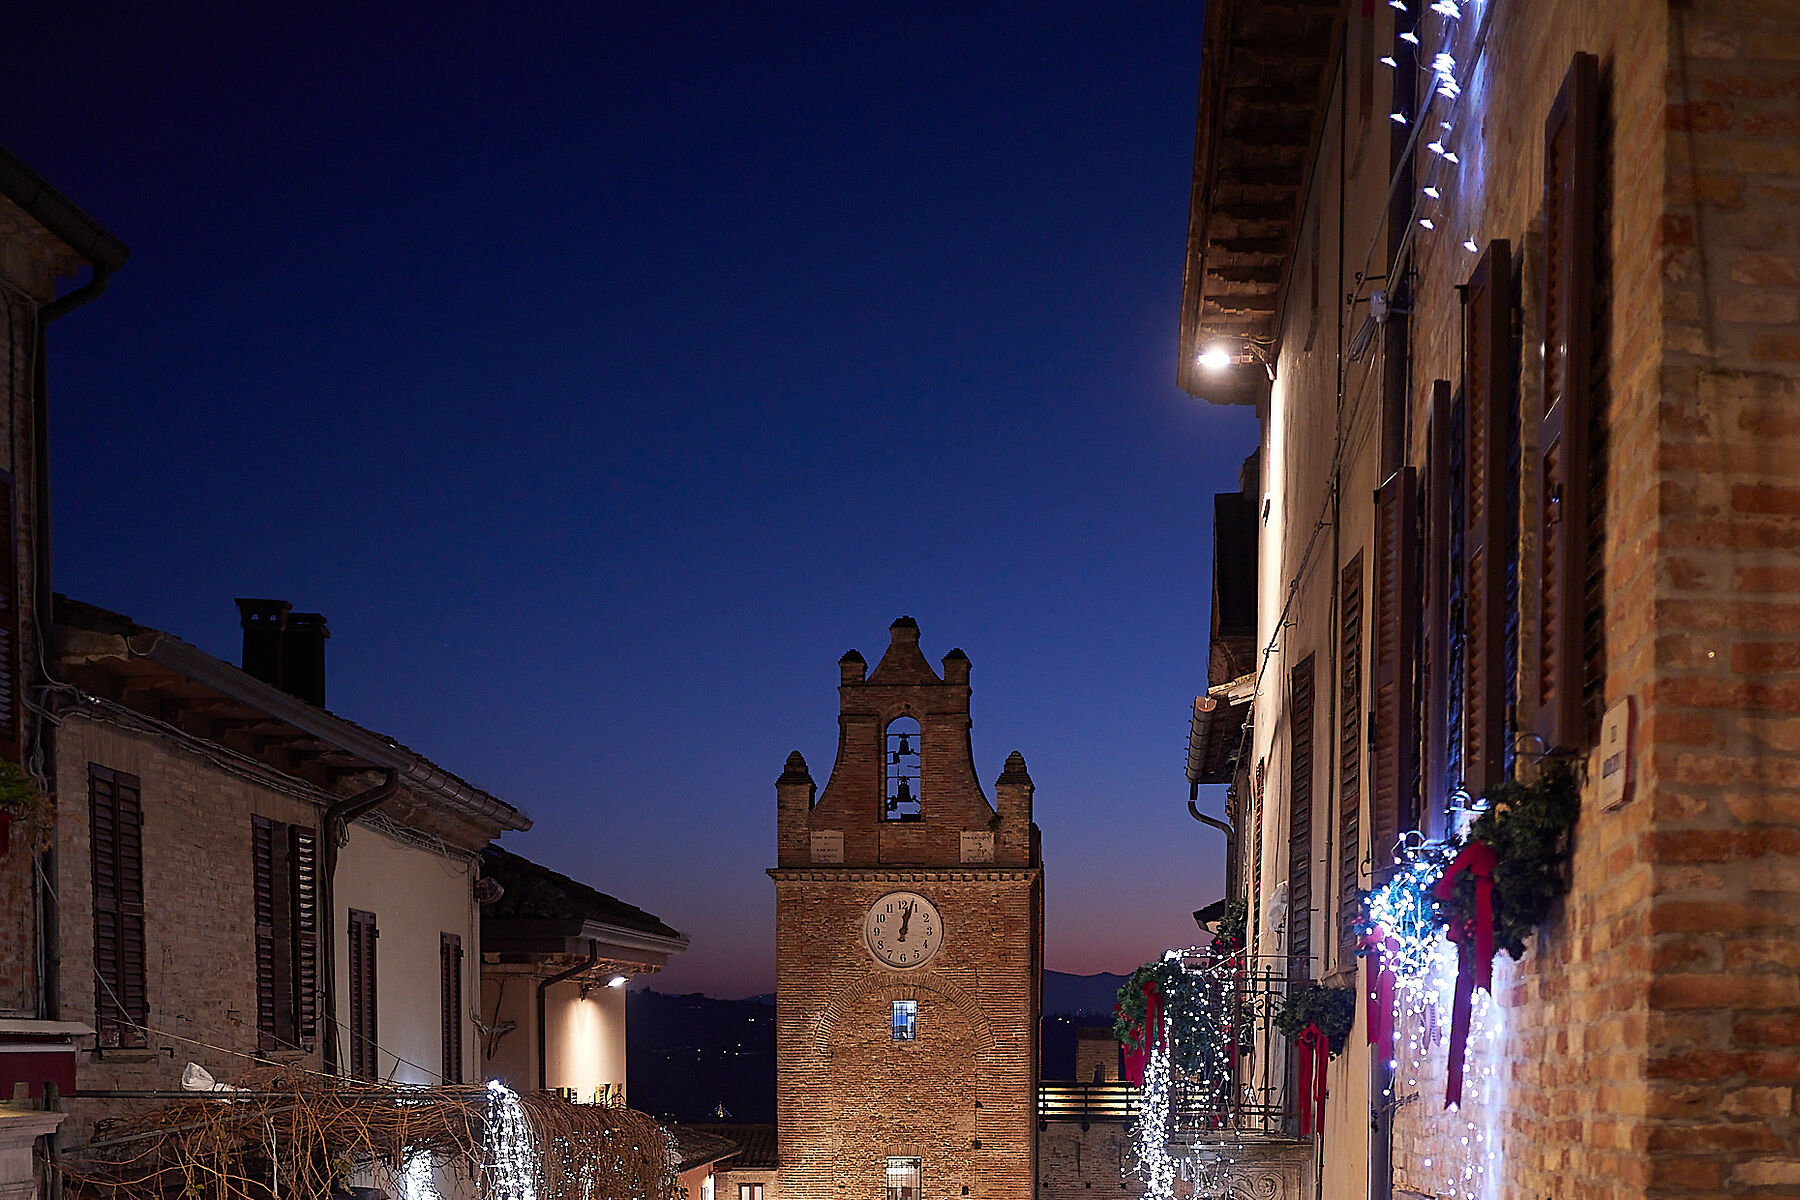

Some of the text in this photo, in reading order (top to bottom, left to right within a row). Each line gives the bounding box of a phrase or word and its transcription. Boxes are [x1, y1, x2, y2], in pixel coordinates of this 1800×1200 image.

[886, 904, 893, 913] 11
[898, 901, 908, 910] 12
[914, 904, 918, 913] 1
[876, 914, 886, 923] 10
[923, 913, 930, 923] 2
[874, 927, 880, 937] 9
[926, 927, 933, 936] 3
[877, 940, 884, 950] 8
[923, 940, 928, 949] 4
[887, 950, 893, 959] 7
[900, 953, 907, 963] 6
[913, 950, 920, 959] 5
